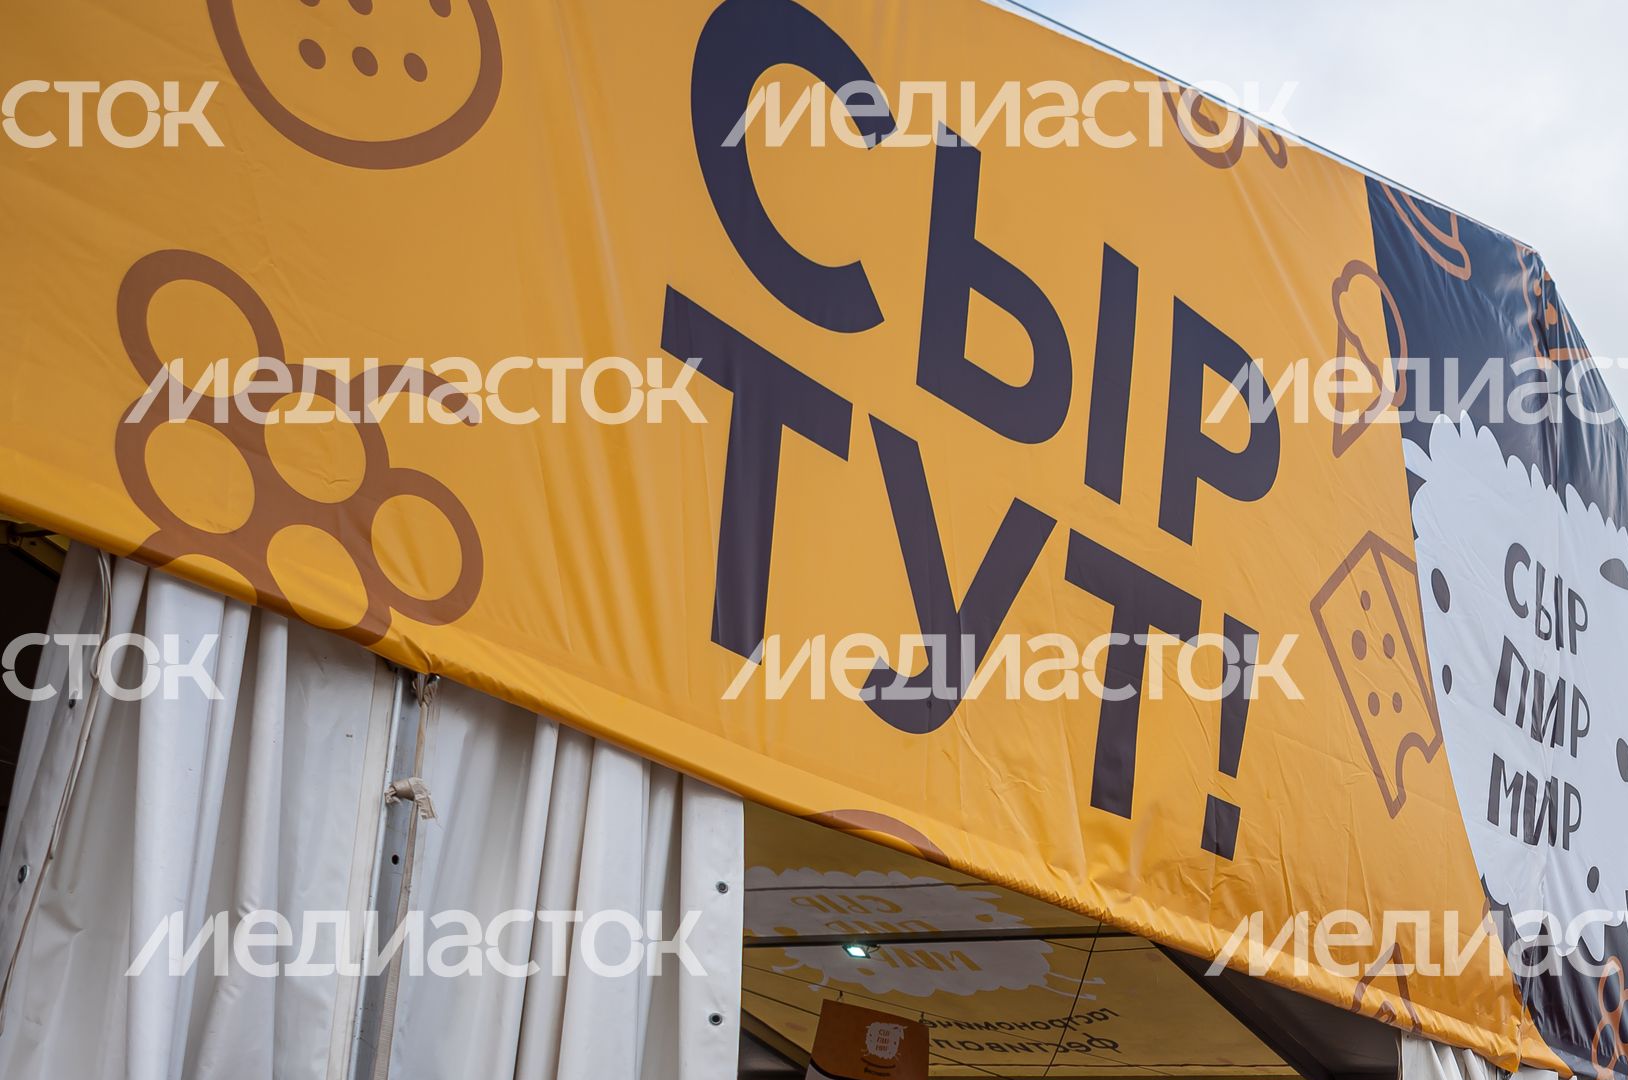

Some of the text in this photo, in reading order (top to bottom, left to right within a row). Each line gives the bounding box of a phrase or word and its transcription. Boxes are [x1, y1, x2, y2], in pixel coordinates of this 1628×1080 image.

[691, 0, 1281, 546] СЫР
[661, 284, 1260, 861] ТУТ!
[1504, 542, 1588, 656] СЫР
[1493, 635, 1591, 759] ПИР
[1487, 752, 1582, 851] МИР
